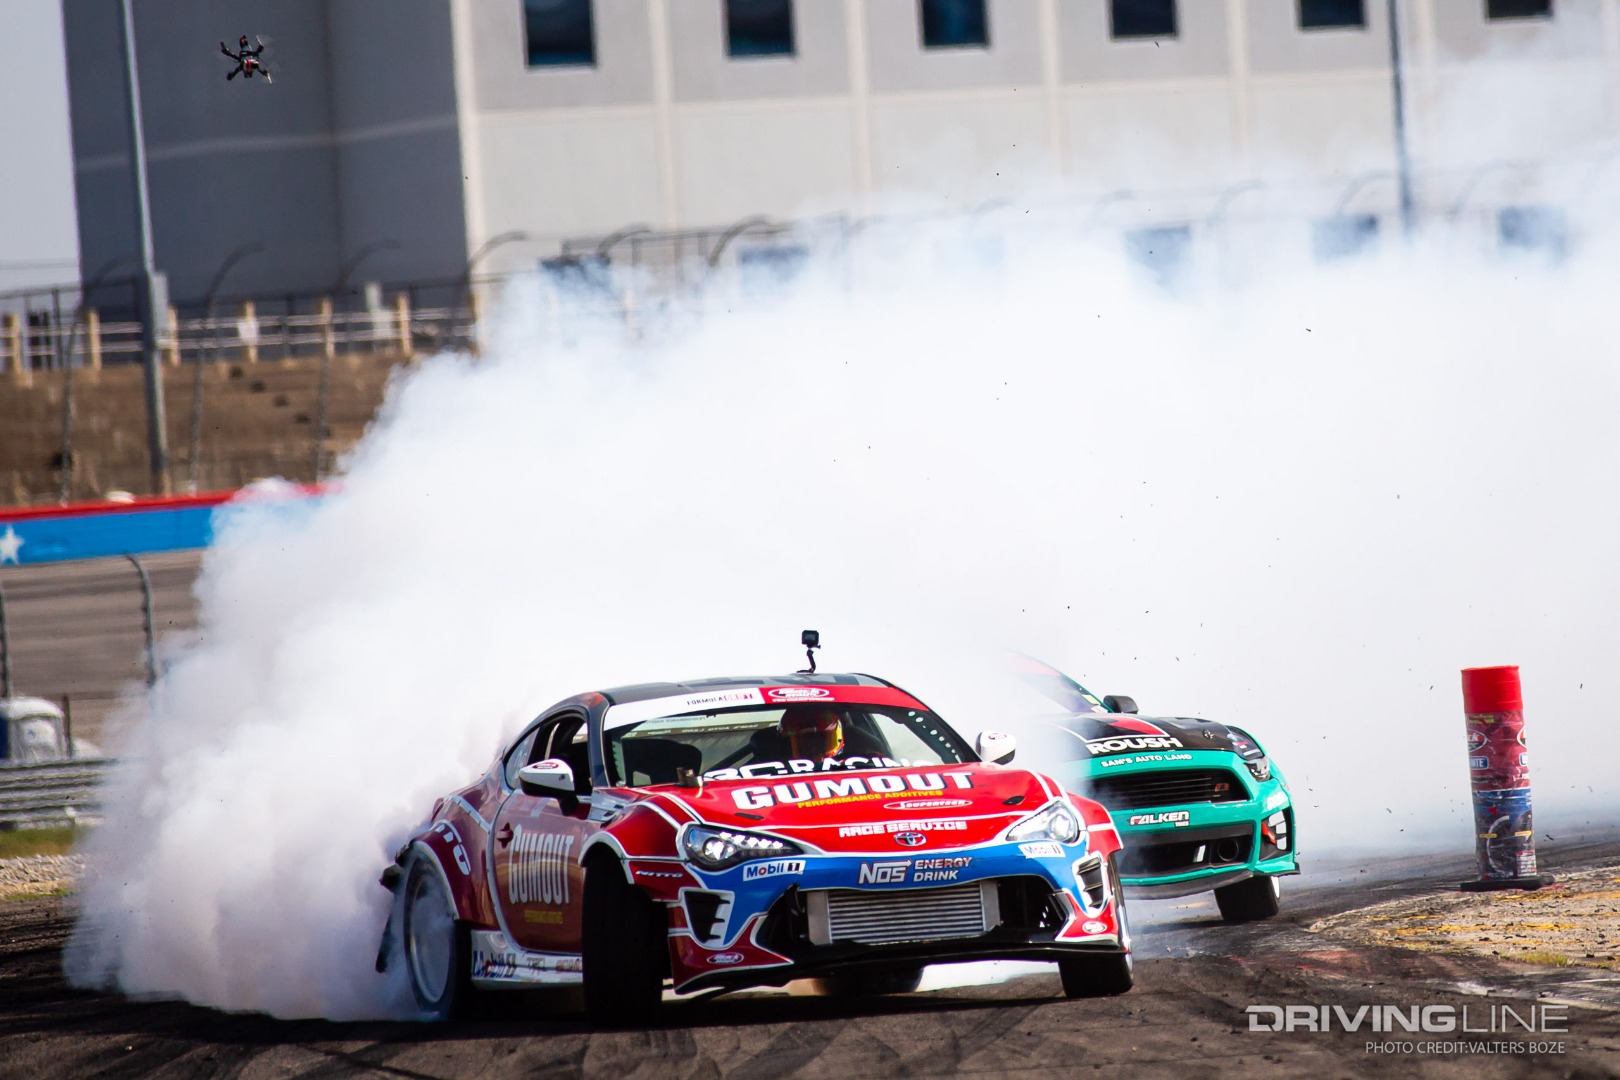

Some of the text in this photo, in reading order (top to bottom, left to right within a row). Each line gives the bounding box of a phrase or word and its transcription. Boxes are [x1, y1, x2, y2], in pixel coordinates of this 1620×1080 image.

[1086, 737, 1183, 755] ROUSH
[1101, 752, 1192, 768] SAM'S AUTO LAND
[731, 771, 975, 810] GUMOUT
[797, 789, 944, 809] PERFORMANCE ADDITIVES
[1126, 809, 1190, 826] FALKEN
[838, 825, 885, 838] RACE
[508, 823, 575, 906] GUMOUT
[746, 862, 801, 879] Mobil 1
[858, 856, 973, 885] NOS ENERGY
[635, 869, 685, 878] NITTO
[913, 870, 958, 883] DRINK
